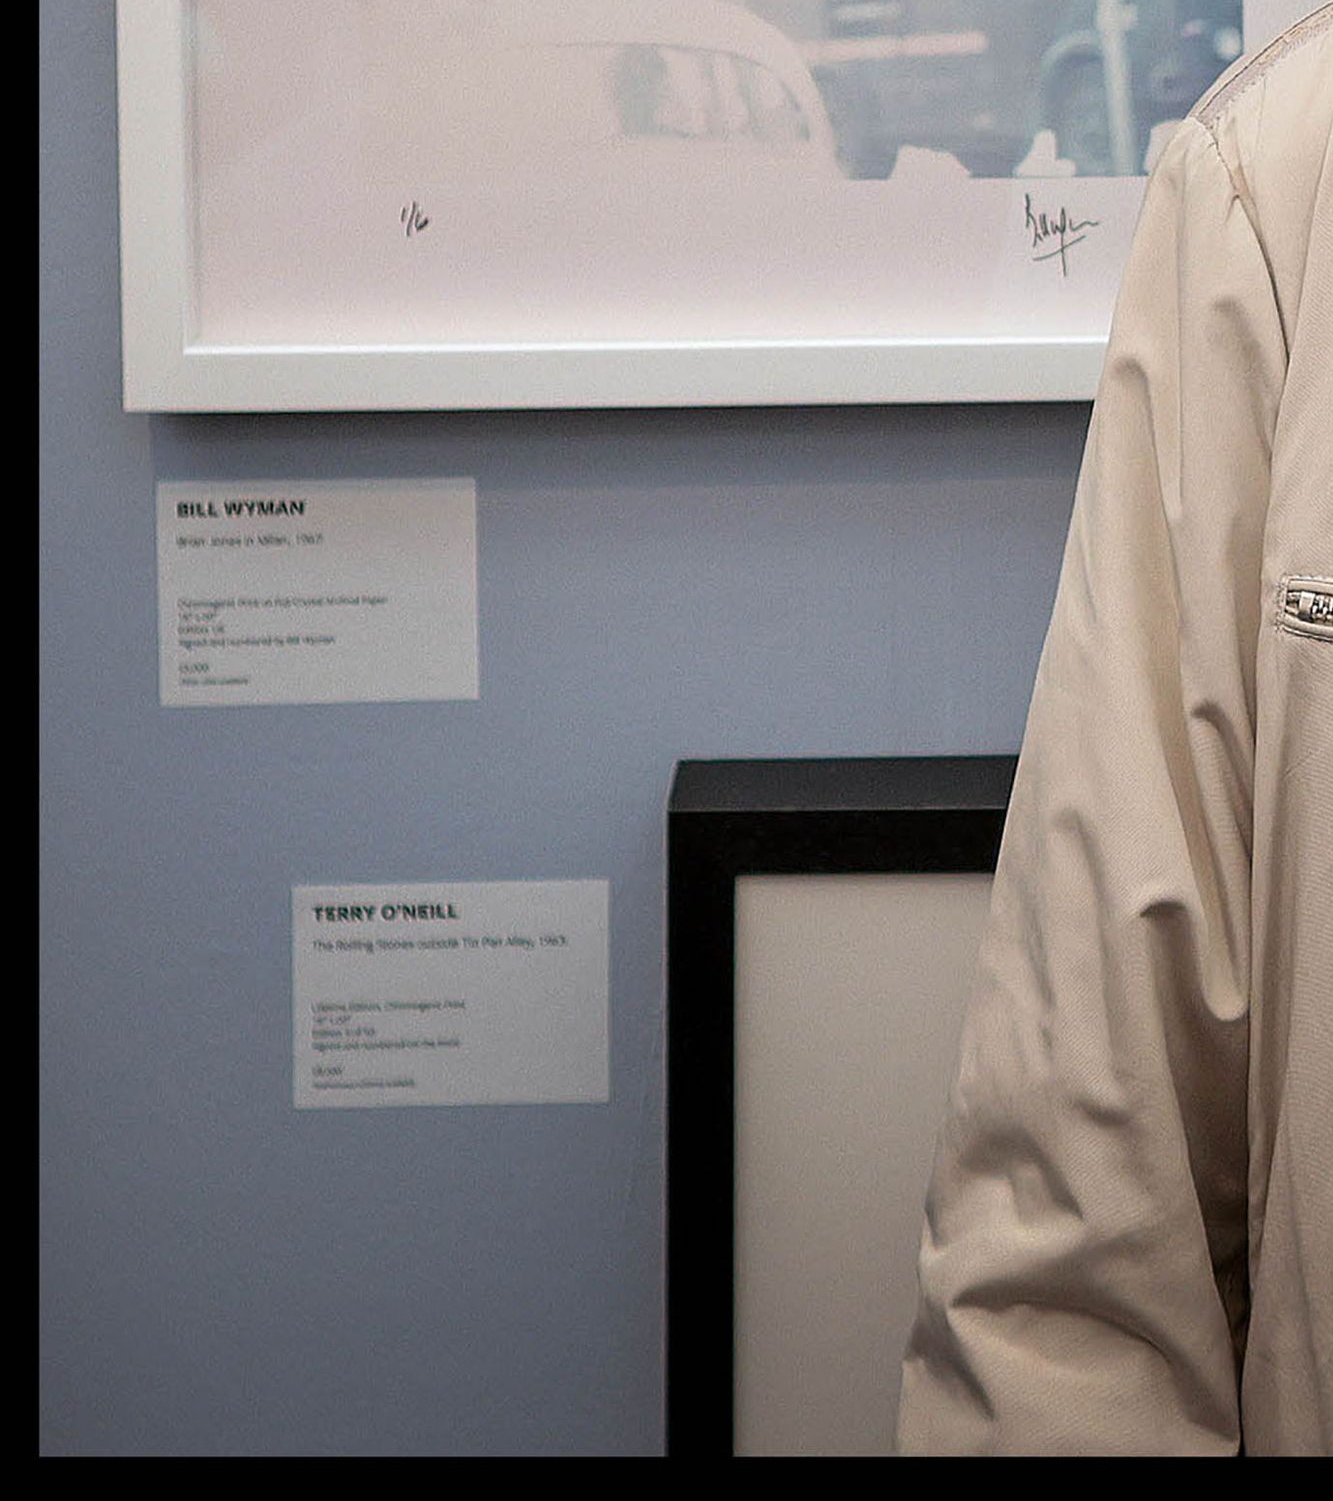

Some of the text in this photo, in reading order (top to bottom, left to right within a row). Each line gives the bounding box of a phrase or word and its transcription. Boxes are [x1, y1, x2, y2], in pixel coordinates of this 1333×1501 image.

[177, 500, 305, 518] BILL WYMAN
[313, 903, 459, 922] TERRY O'NEILL
